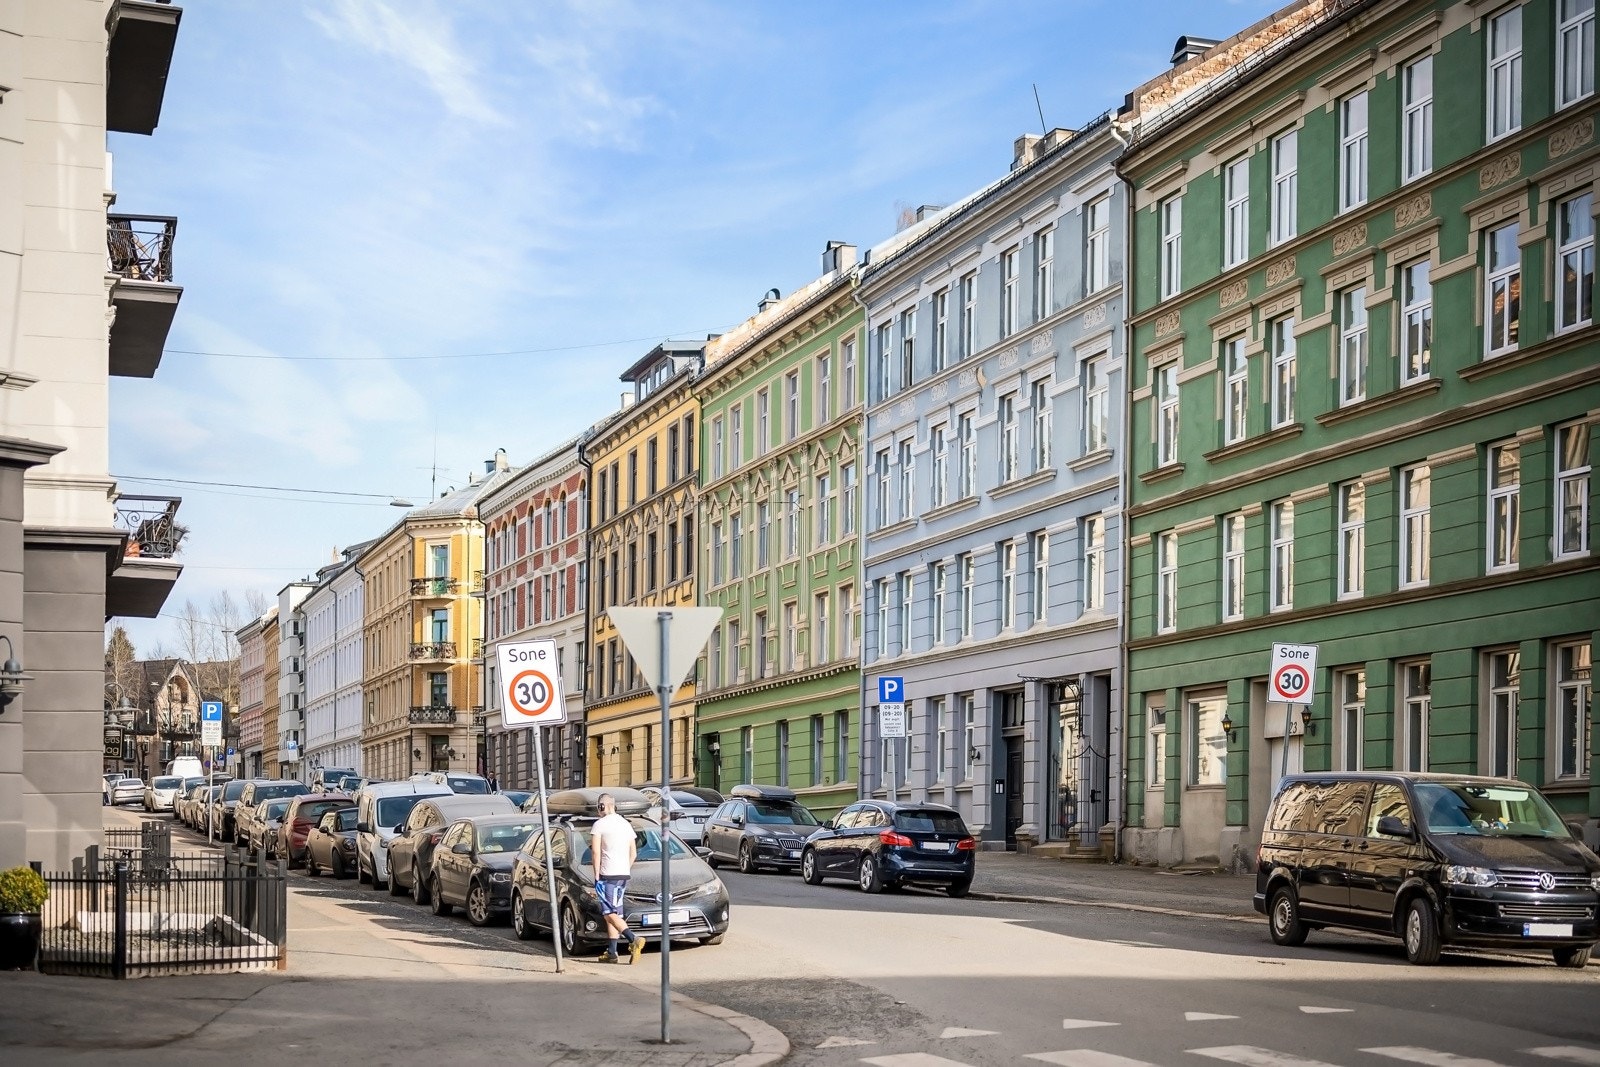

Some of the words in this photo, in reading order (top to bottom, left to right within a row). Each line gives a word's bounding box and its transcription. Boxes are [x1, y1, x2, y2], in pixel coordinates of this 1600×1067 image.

[508, 648, 546, 663] Sone
[1279, 647, 1310, 660] Sone
[884, 680, 898, 700] P
[1280, 672, 1304, 691] 30
[517, 681, 546, 705] 30
[206, 704, 218, 719] P
